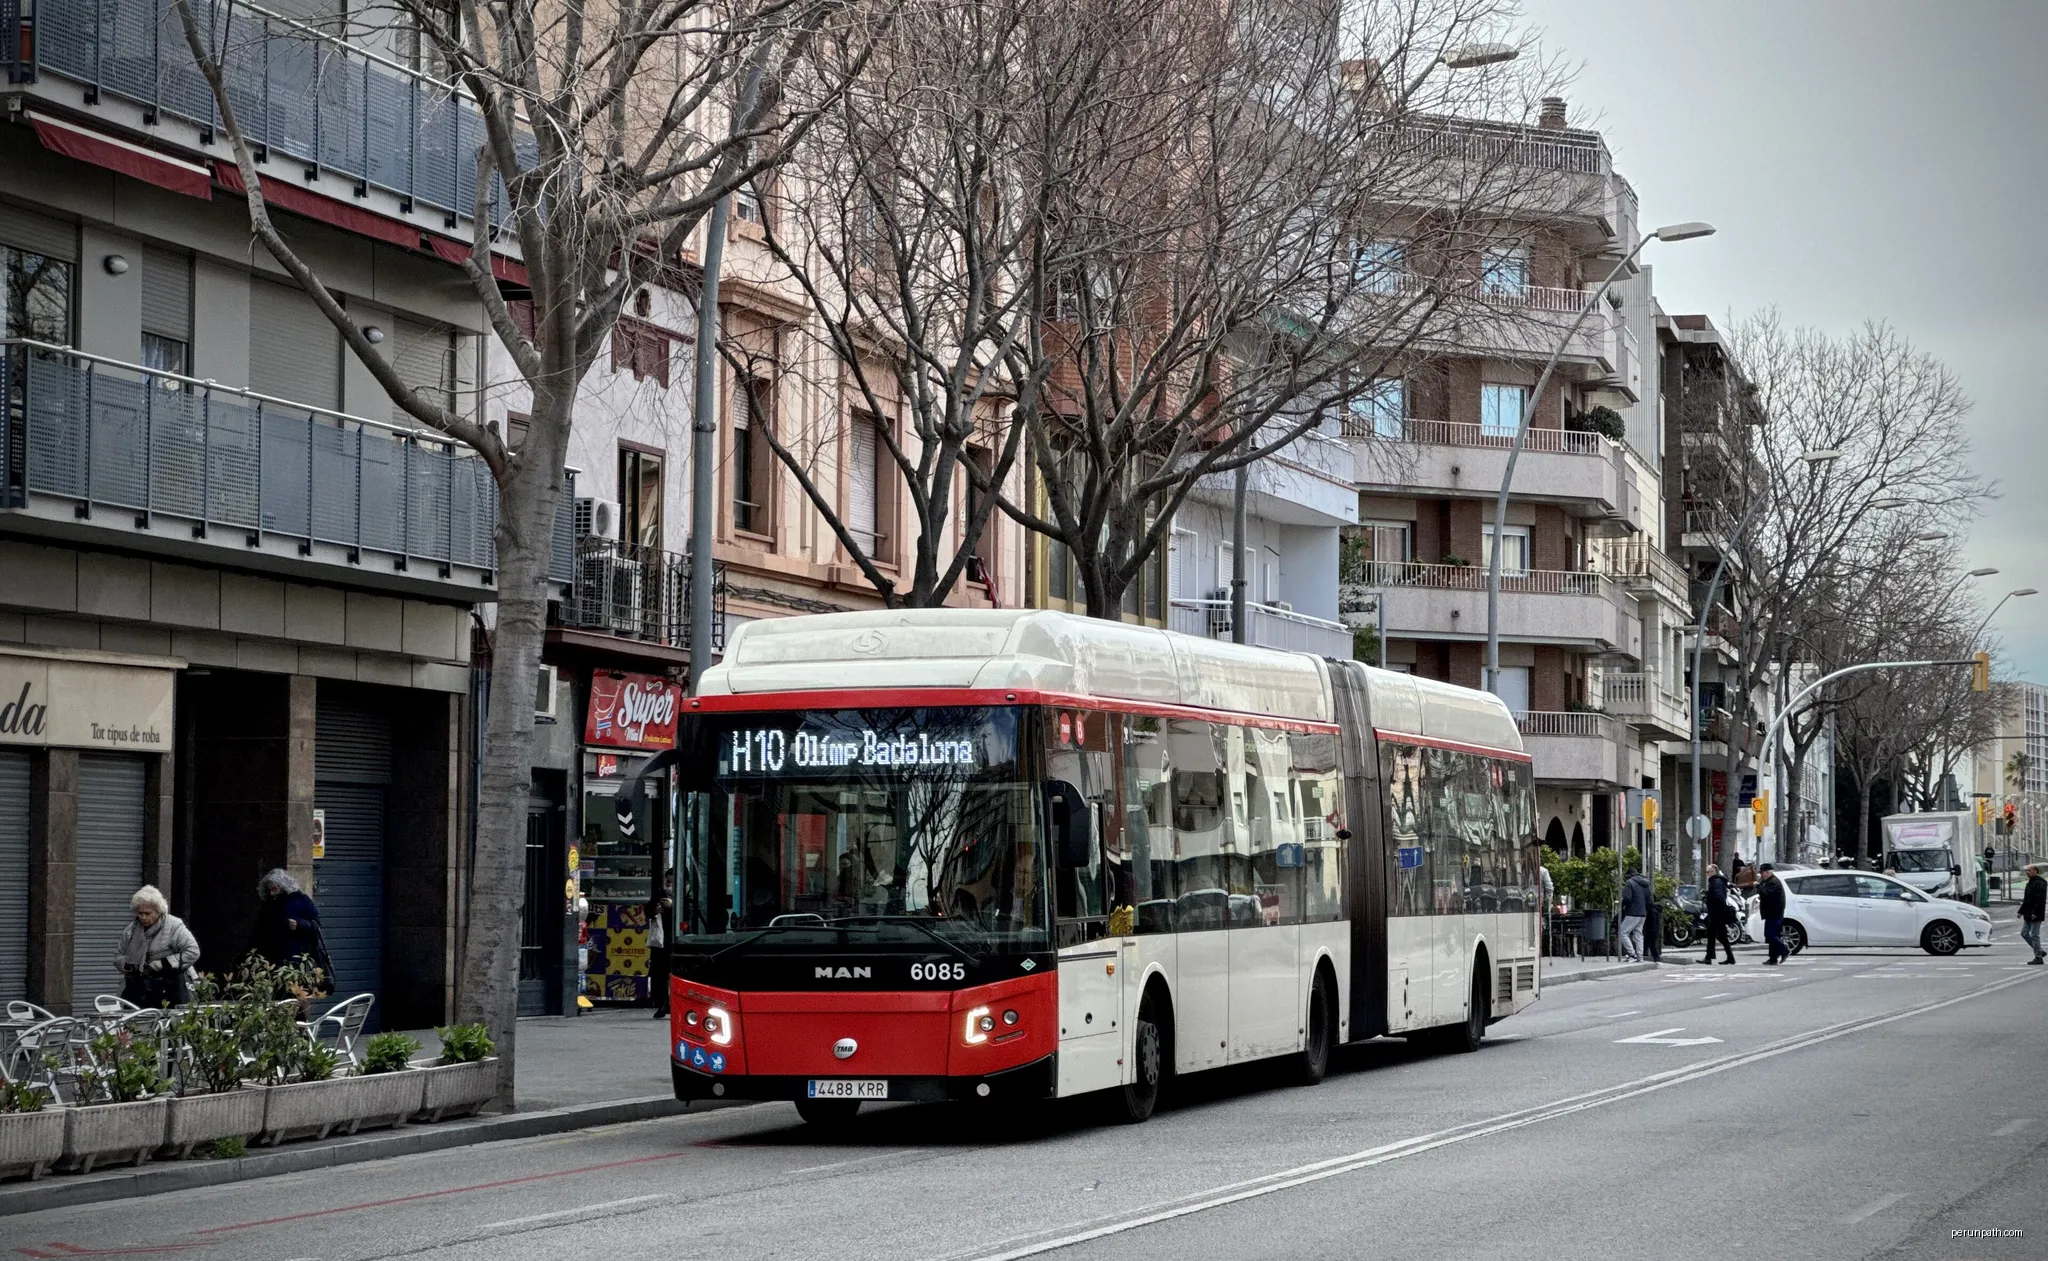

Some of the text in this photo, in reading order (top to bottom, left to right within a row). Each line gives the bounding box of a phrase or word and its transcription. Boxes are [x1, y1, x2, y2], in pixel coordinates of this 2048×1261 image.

[617, 681, 674, 743] Super
[90, 722, 160, 746] Tot tipus de roba
[732, 730, 785, 772] H10
[814, 966, 872, 979] MAN
[910, 962, 965, 981] 6085
[818, 1082, 885, 1096] 4488 KRR
